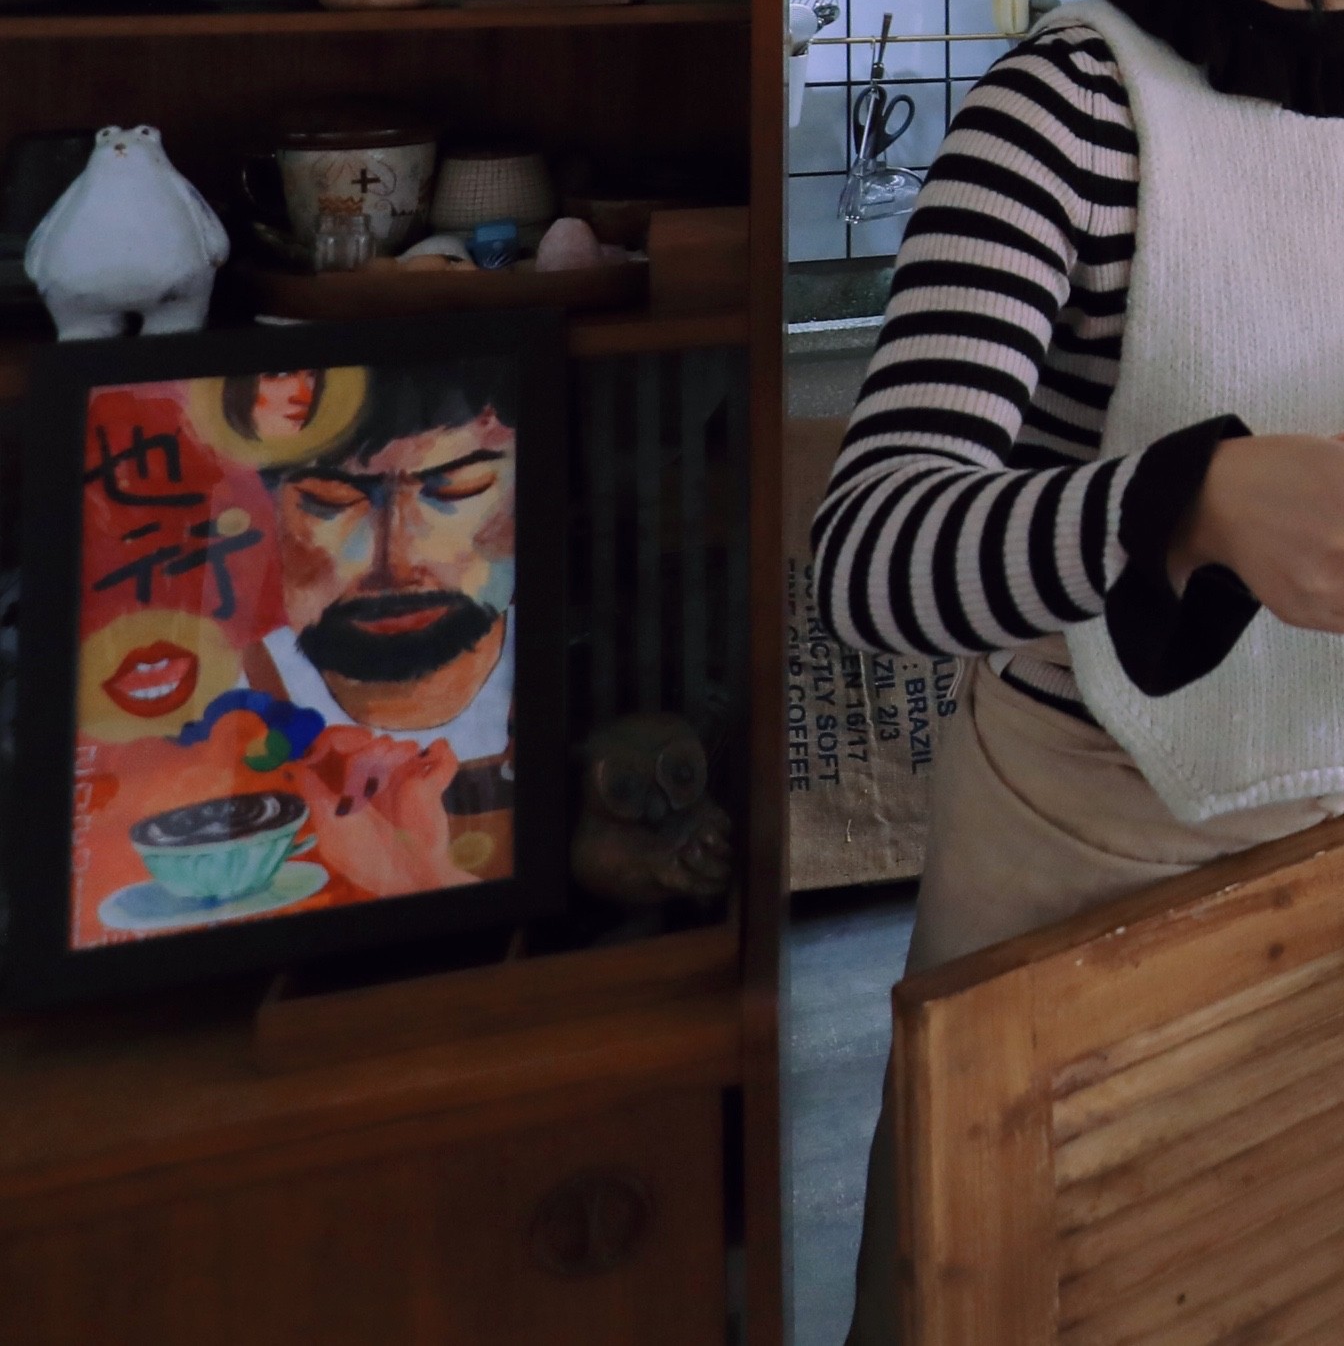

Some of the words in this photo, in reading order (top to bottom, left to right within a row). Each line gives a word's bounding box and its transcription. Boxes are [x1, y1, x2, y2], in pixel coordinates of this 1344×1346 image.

[82, 425, 264, 620] 也行
[788, 686, 810, 792] COFFEE
[815, 716, 840, 785] SOFT
[846, 701, 868, 763] 16/17
[877, 705, 900, 741] 2/3
[905, 678, 933, 774] BRAZIL
